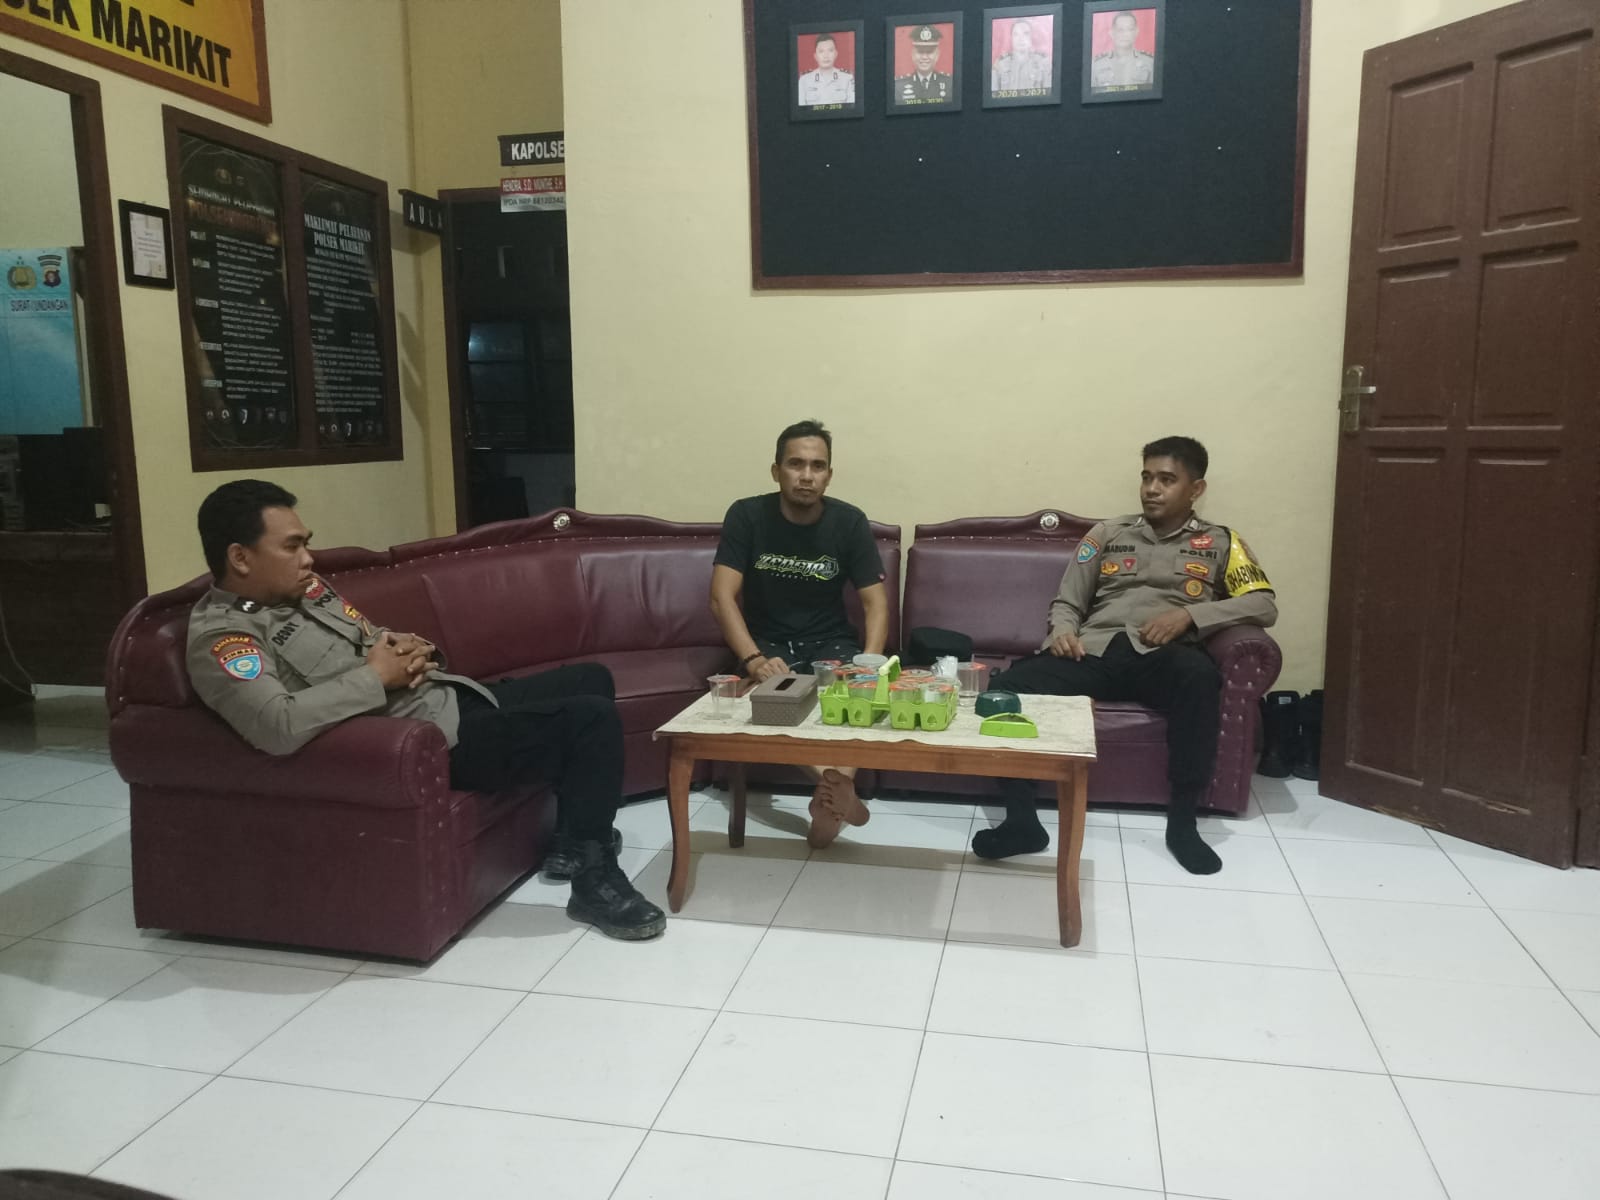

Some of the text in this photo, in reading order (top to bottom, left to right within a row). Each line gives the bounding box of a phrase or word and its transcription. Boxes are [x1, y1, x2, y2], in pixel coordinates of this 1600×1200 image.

[91, 0, 231, 88] MARIKIT
[409, 202, 443, 230] AULA
[1179, 548, 1218, 560] POLRI
